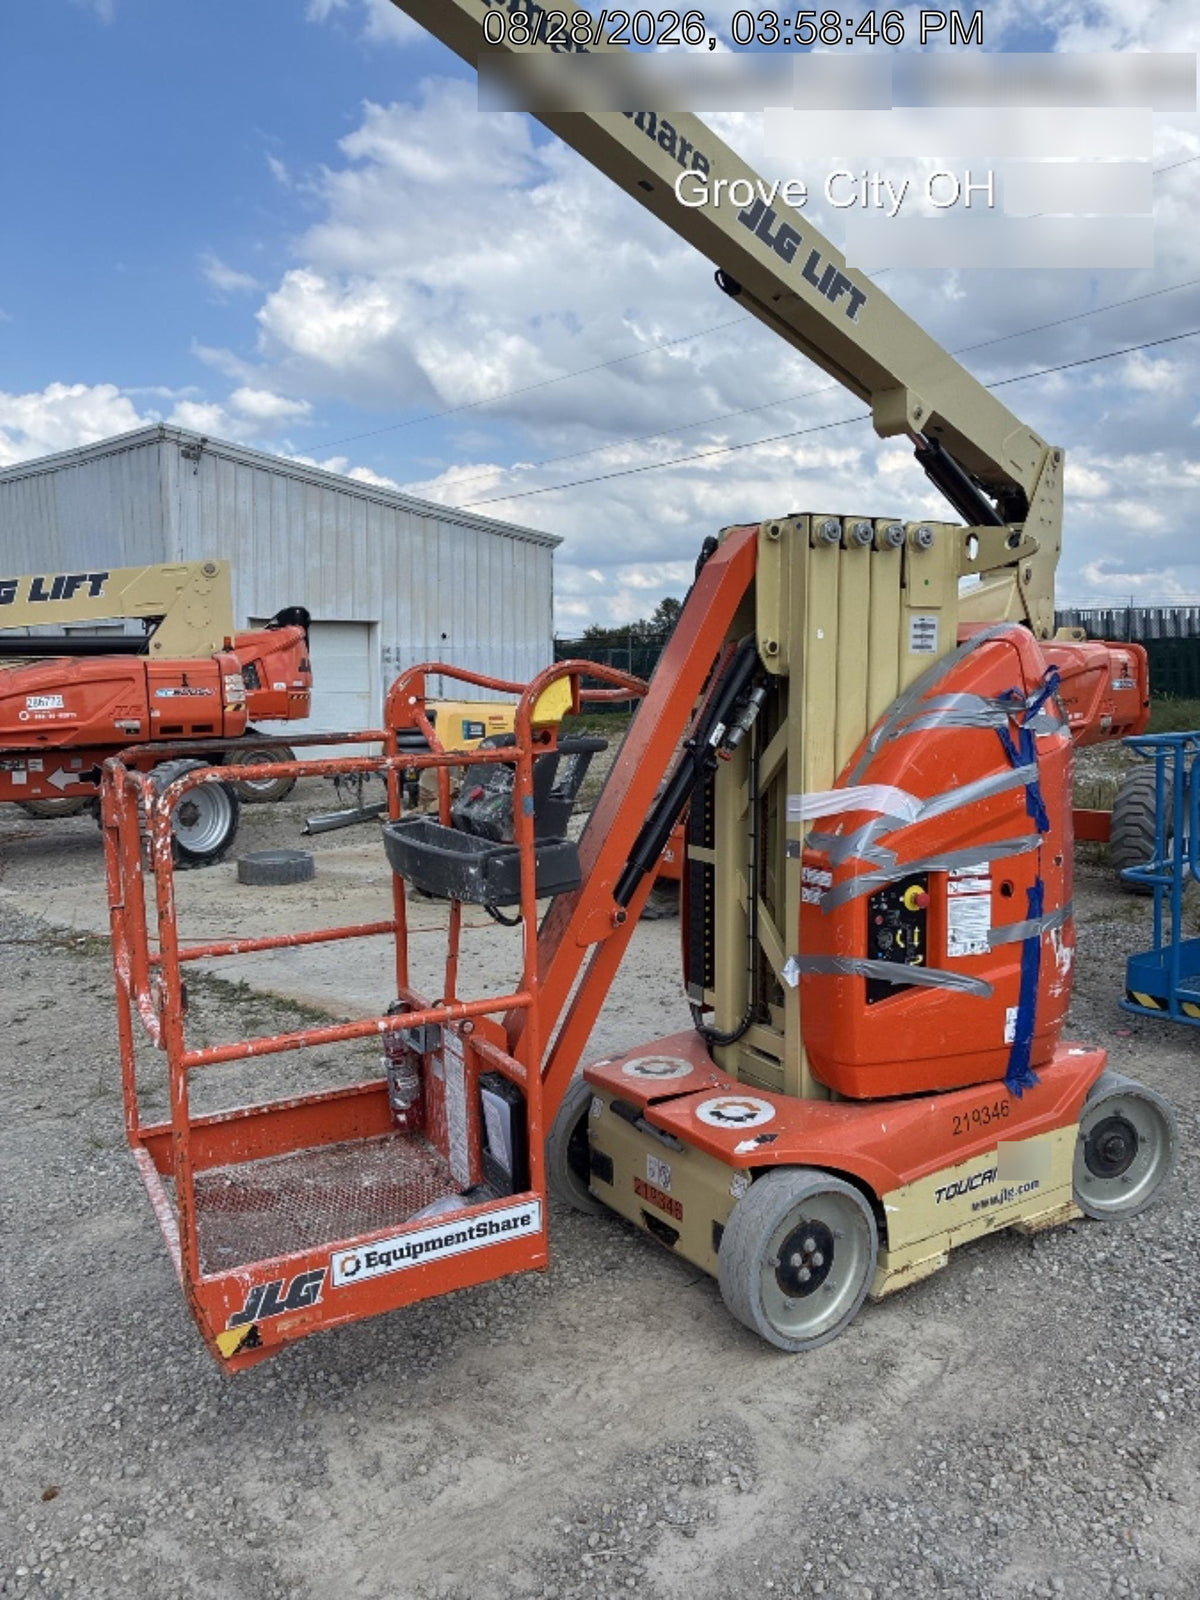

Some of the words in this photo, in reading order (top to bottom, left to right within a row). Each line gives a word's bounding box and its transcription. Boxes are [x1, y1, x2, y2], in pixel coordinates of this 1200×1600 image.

[737, 196, 803, 265] JLG
[801, 248, 868, 321] LIFT
[28, 571, 110, 602] LIFT
[952, 1099, 1011, 1136] 219346
[971, 1179, 1041, 1212] www.jlg.com
[364, 1213, 532, 1269] EquipmentShare
[226, 1267, 328, 1330] JLG
